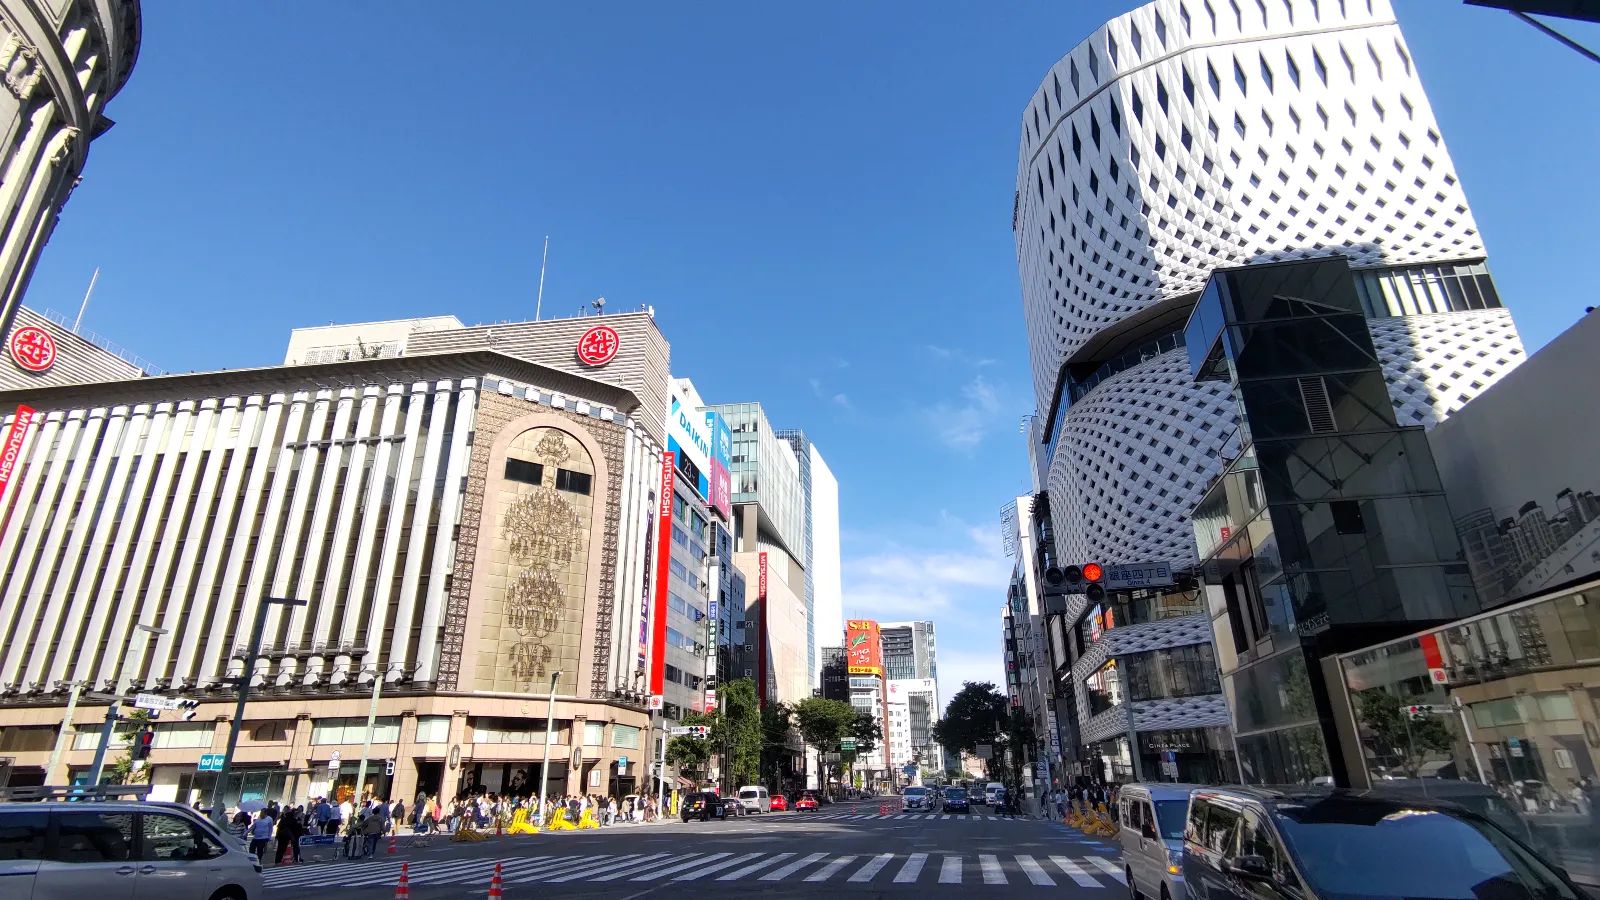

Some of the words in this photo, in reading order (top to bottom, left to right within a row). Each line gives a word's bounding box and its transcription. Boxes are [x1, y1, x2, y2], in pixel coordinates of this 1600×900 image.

[0, 411, 31, 482] MITSUKOSHI
[680, 411, 709, 458] DAIKIN
[662, 455, 673, 517] MITSUKOSHI
[1109, 567, 1167, 581] 銀座四丁目
